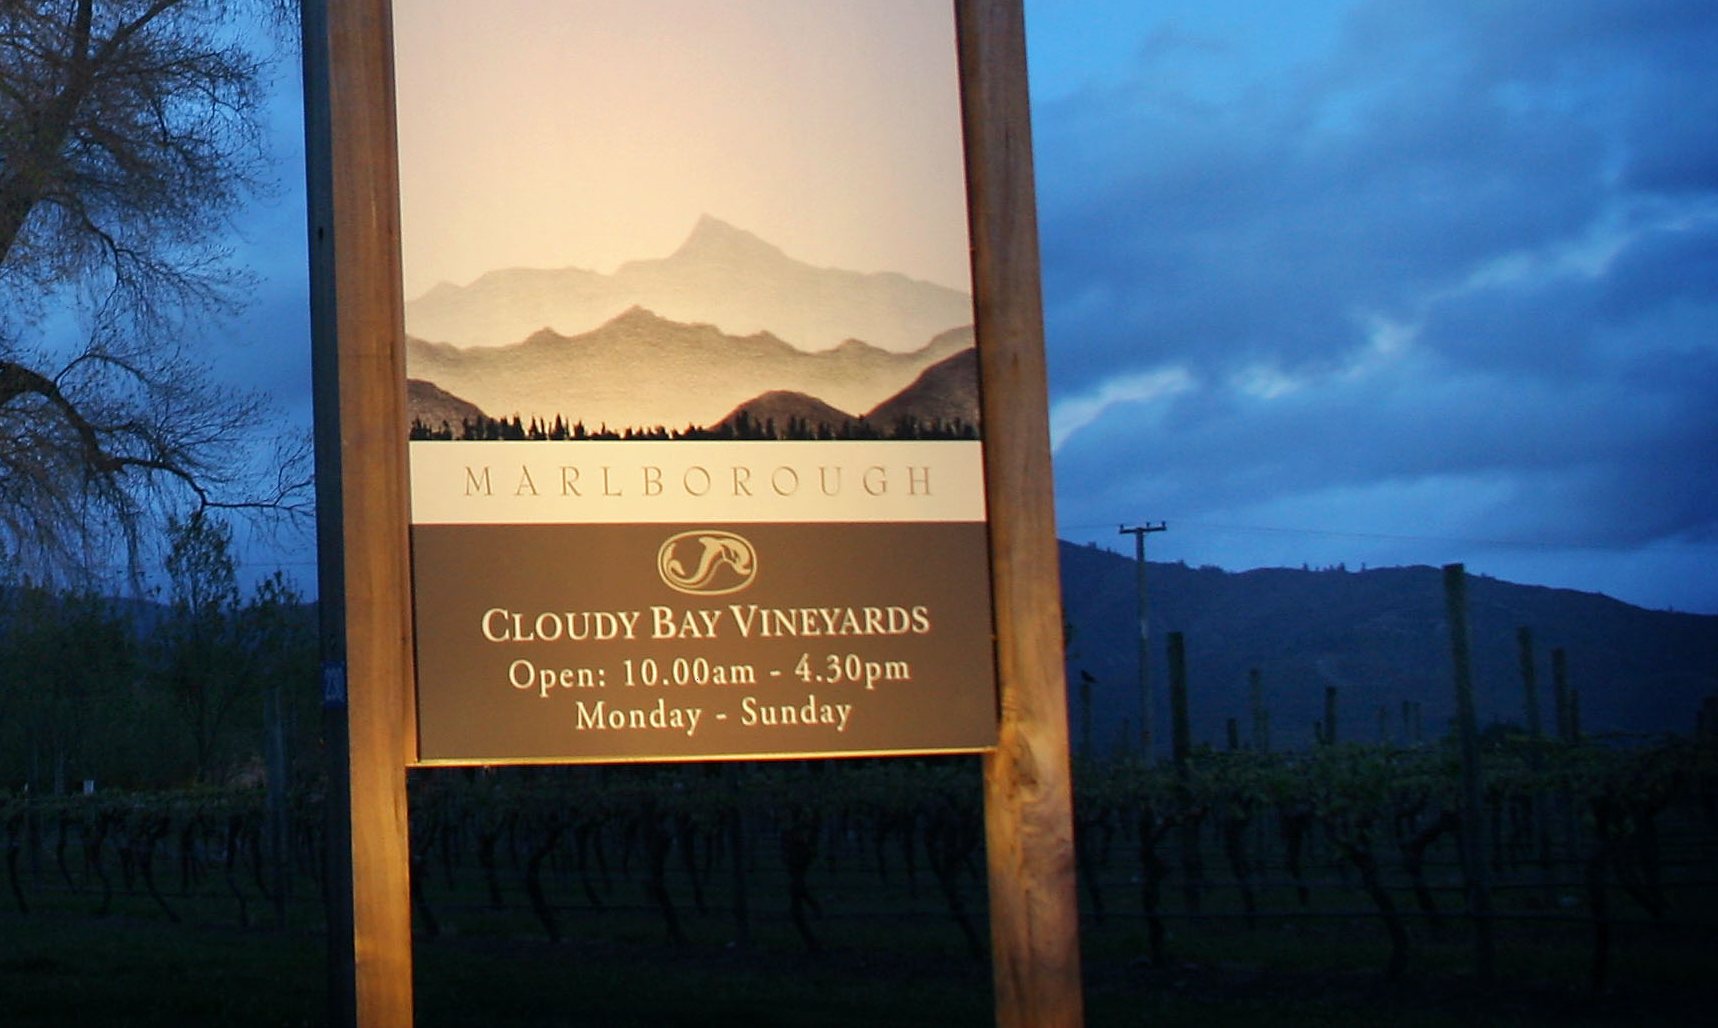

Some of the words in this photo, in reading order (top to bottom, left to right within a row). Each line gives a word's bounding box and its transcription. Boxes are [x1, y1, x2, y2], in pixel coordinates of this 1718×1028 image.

[463, 465, 933, 497] MARLBOROUGH
[481, 607, 641, 642] CLOUDY
[650, 605, 723, 639] BAY
[729, 603, 931, 638] VINEYARDS
[508, 659, 605, 696] Open:
[623, 657, 756, 687] 10.00am
[794, 652, 911, 689] 4.30pm
[576, 700, 702, 735] Monday
[741, 696, 852, 731] Sunday
